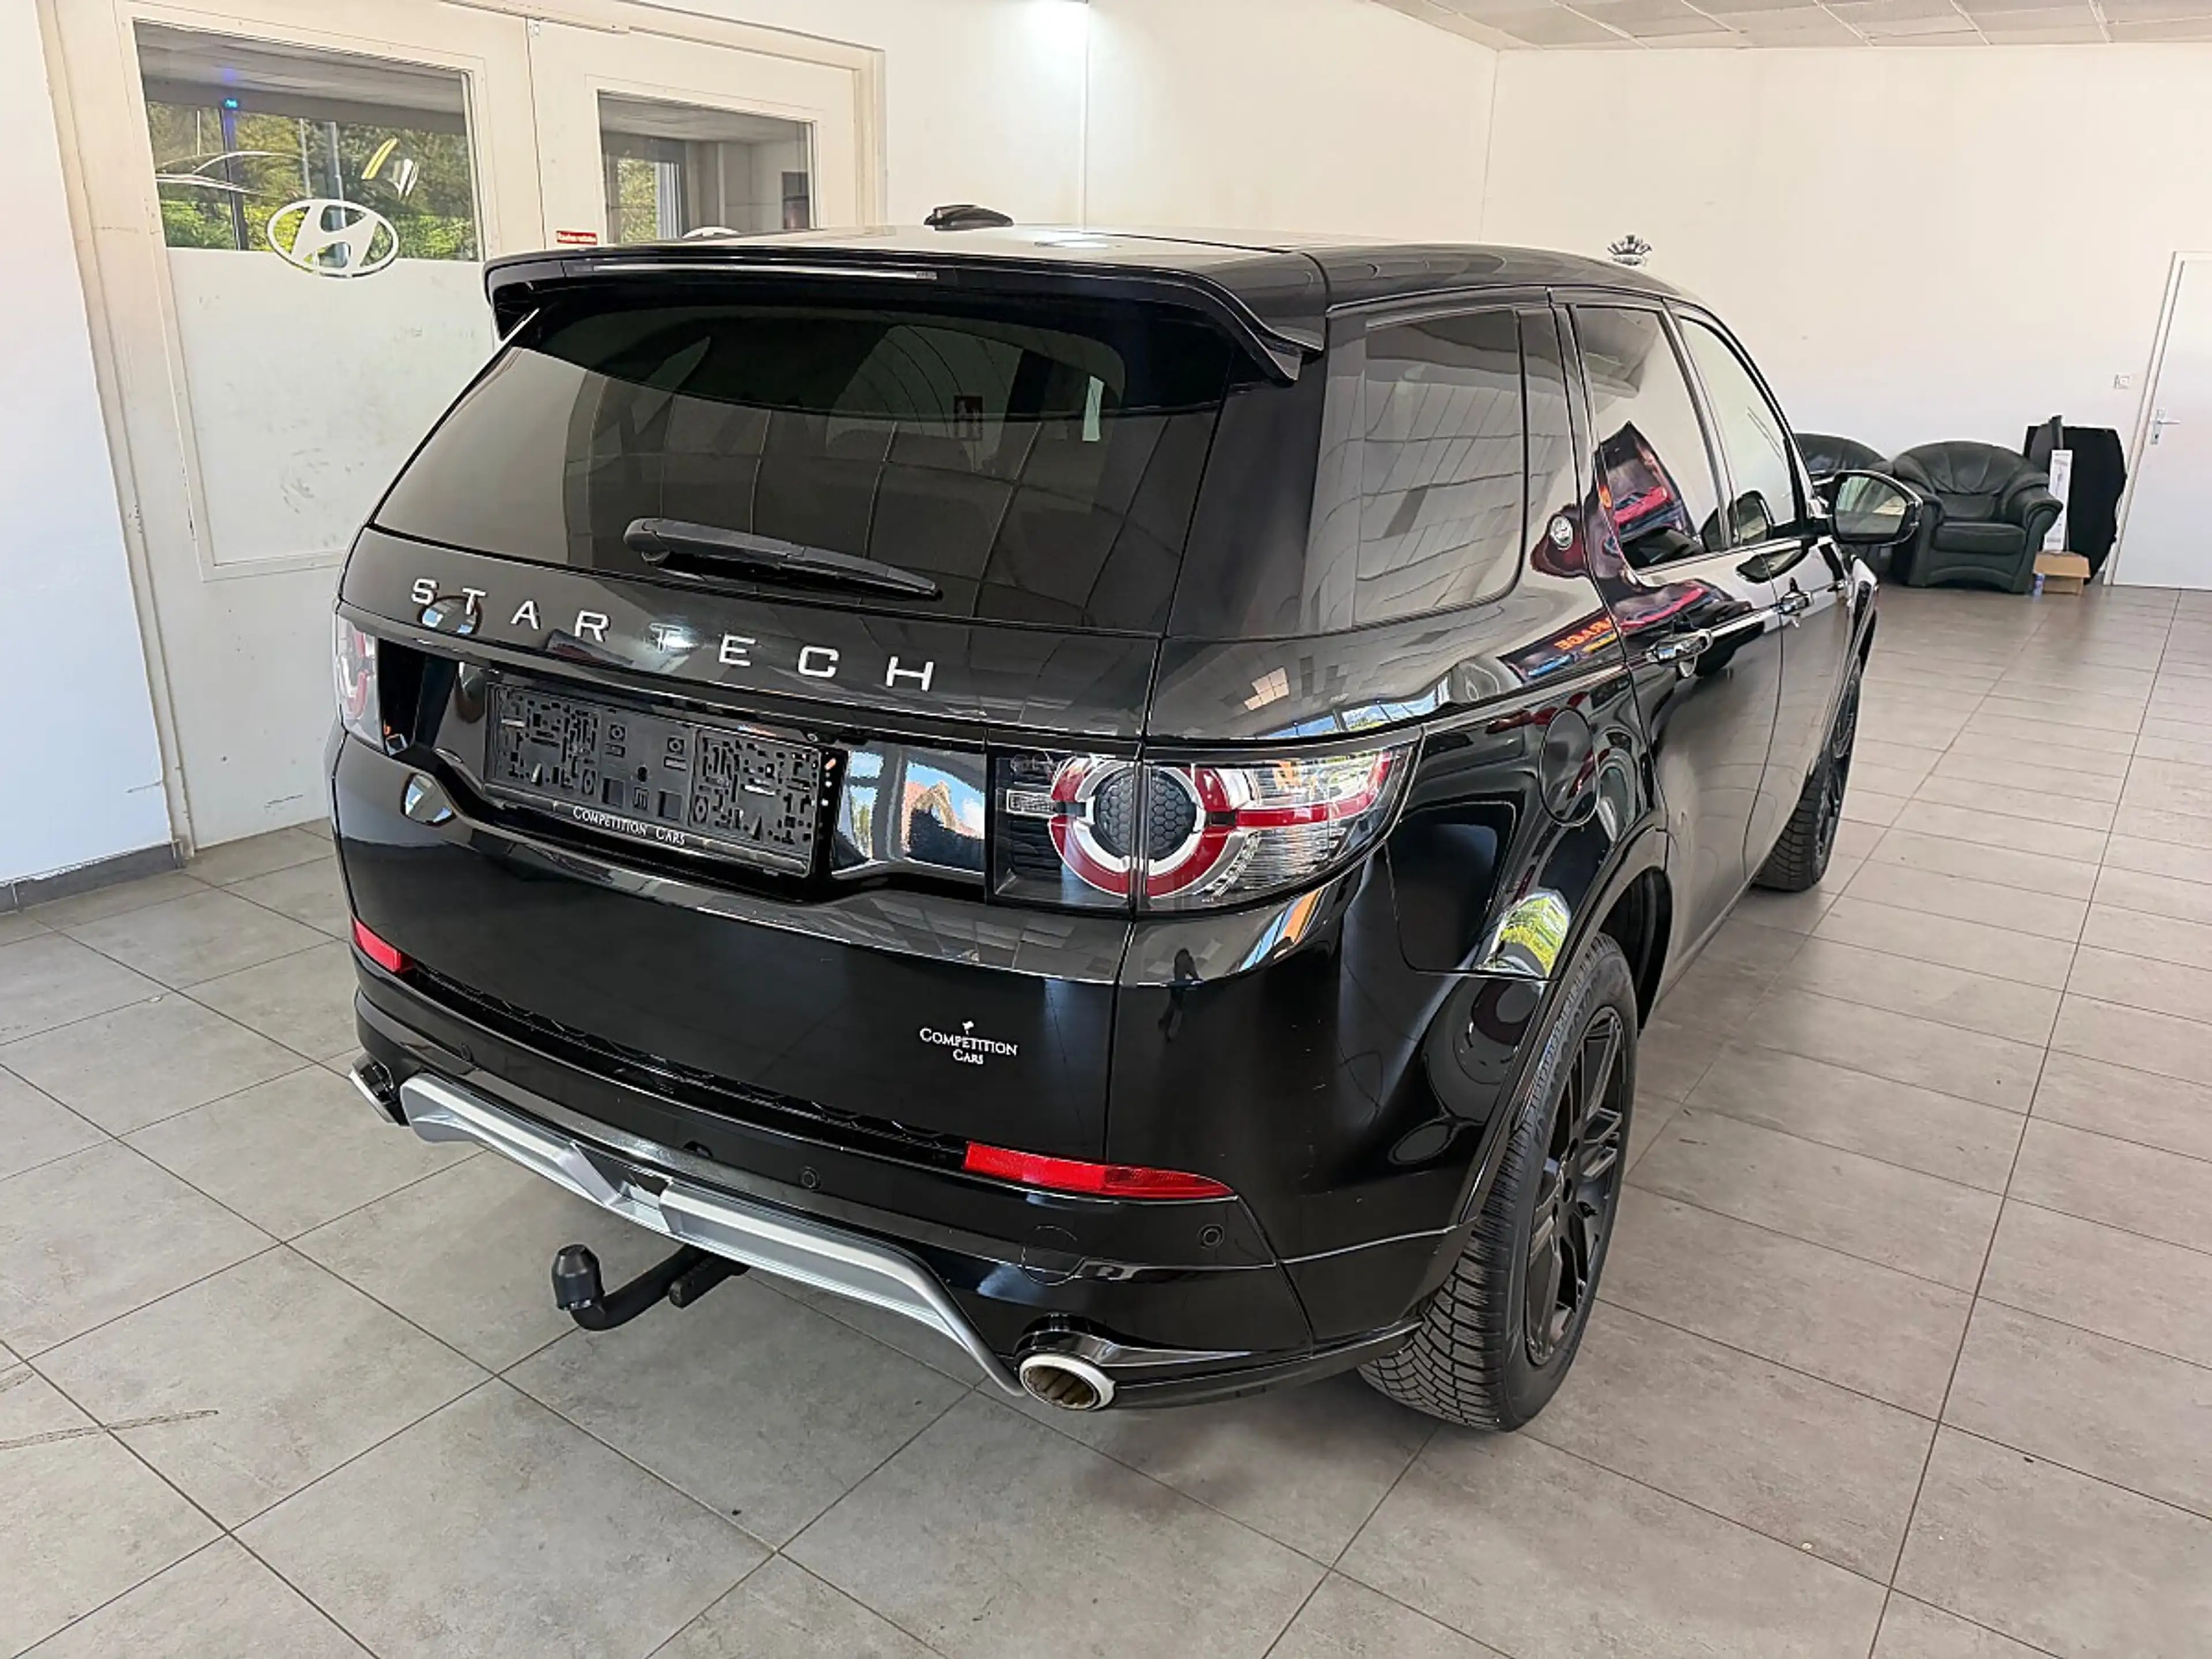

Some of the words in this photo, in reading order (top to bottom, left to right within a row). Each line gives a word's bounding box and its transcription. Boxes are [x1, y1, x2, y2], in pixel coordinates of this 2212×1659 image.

[410, 578, 934, 692] STARTECH
[573, 806, 647, 836] COMPETITION
[656, 827, 684, 844] CARS
[920, 1027, 1018, 1056] COMPETITION
[953, 1049, 983, 1065] CARS
